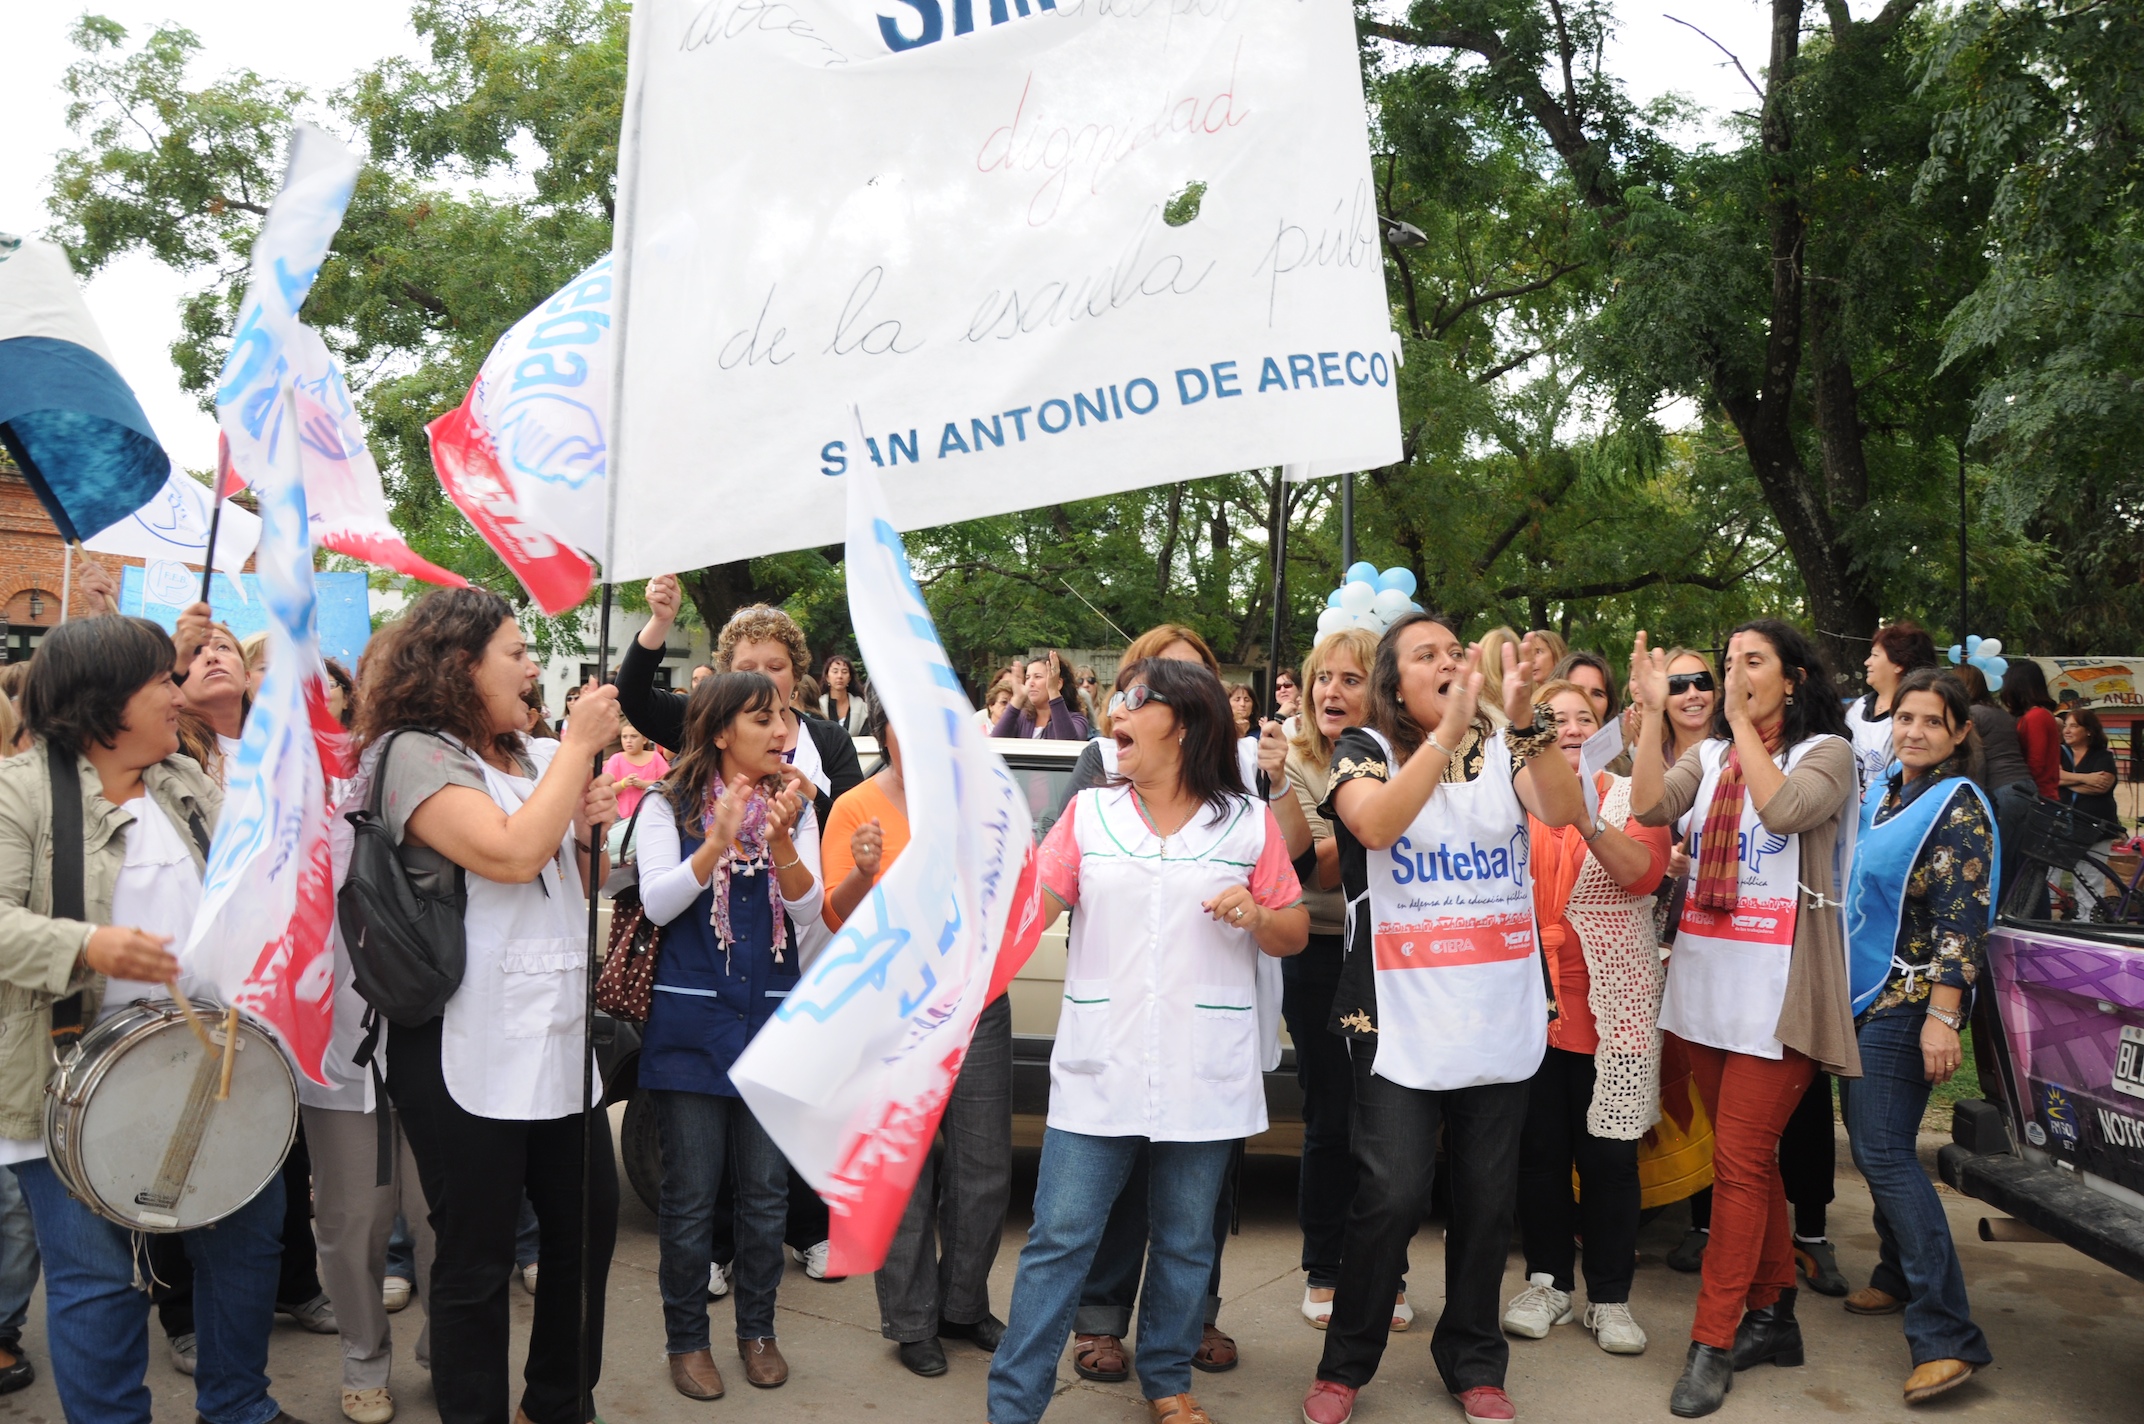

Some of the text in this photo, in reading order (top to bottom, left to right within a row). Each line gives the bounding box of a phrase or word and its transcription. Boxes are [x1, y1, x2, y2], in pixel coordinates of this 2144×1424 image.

[718, 282, 795, 370] de
[822, 265, 926, 355] la
[937, 374, 1160, 459] ANTONIO
[1175, 360, 1243, 406] DE
[1258, 350, 1389, 393] ARECO
[1390, 835, 1509, 885] Suteba
[1409, 898, 1440, 912] defensa
[1443, 895, 1453, 906] de
[1456, 895, 1465, 905] la
[1734, 915, 1778, 929] CTA
[1429, 938, 1475, 954] CTERA
[2117, 1042, 2144, 1084] BL
